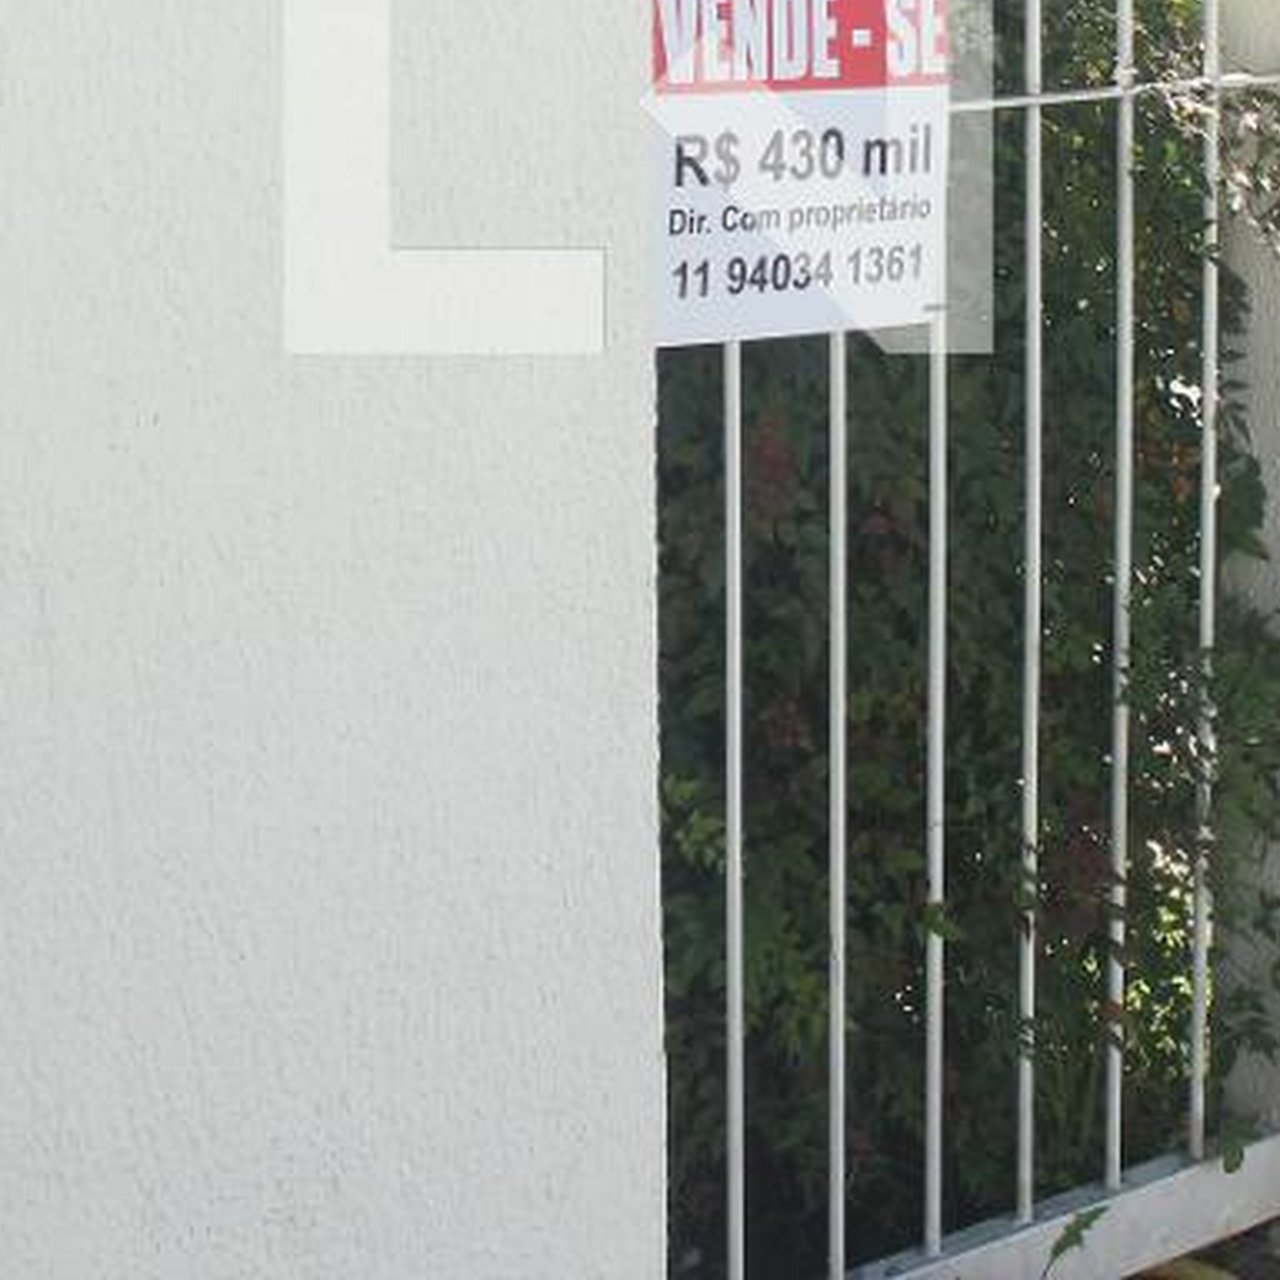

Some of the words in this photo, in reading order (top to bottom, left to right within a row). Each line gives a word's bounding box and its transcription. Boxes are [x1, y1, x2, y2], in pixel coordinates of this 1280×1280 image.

[851, 28, 873, 47] -
[674, 129, 741, 192] R$
[758, 126, 846, 182] 430
[862, 124, 932, 178] mil
[668, 208, 712, 236] Dir.
[721, 205, 781, 233] Com
[788, 195, 932, 235] proprietário
[671, 260, 710, 299] 11
[726, 251, 834, 295] 94034
[848, 244, 923, 286] 1361
